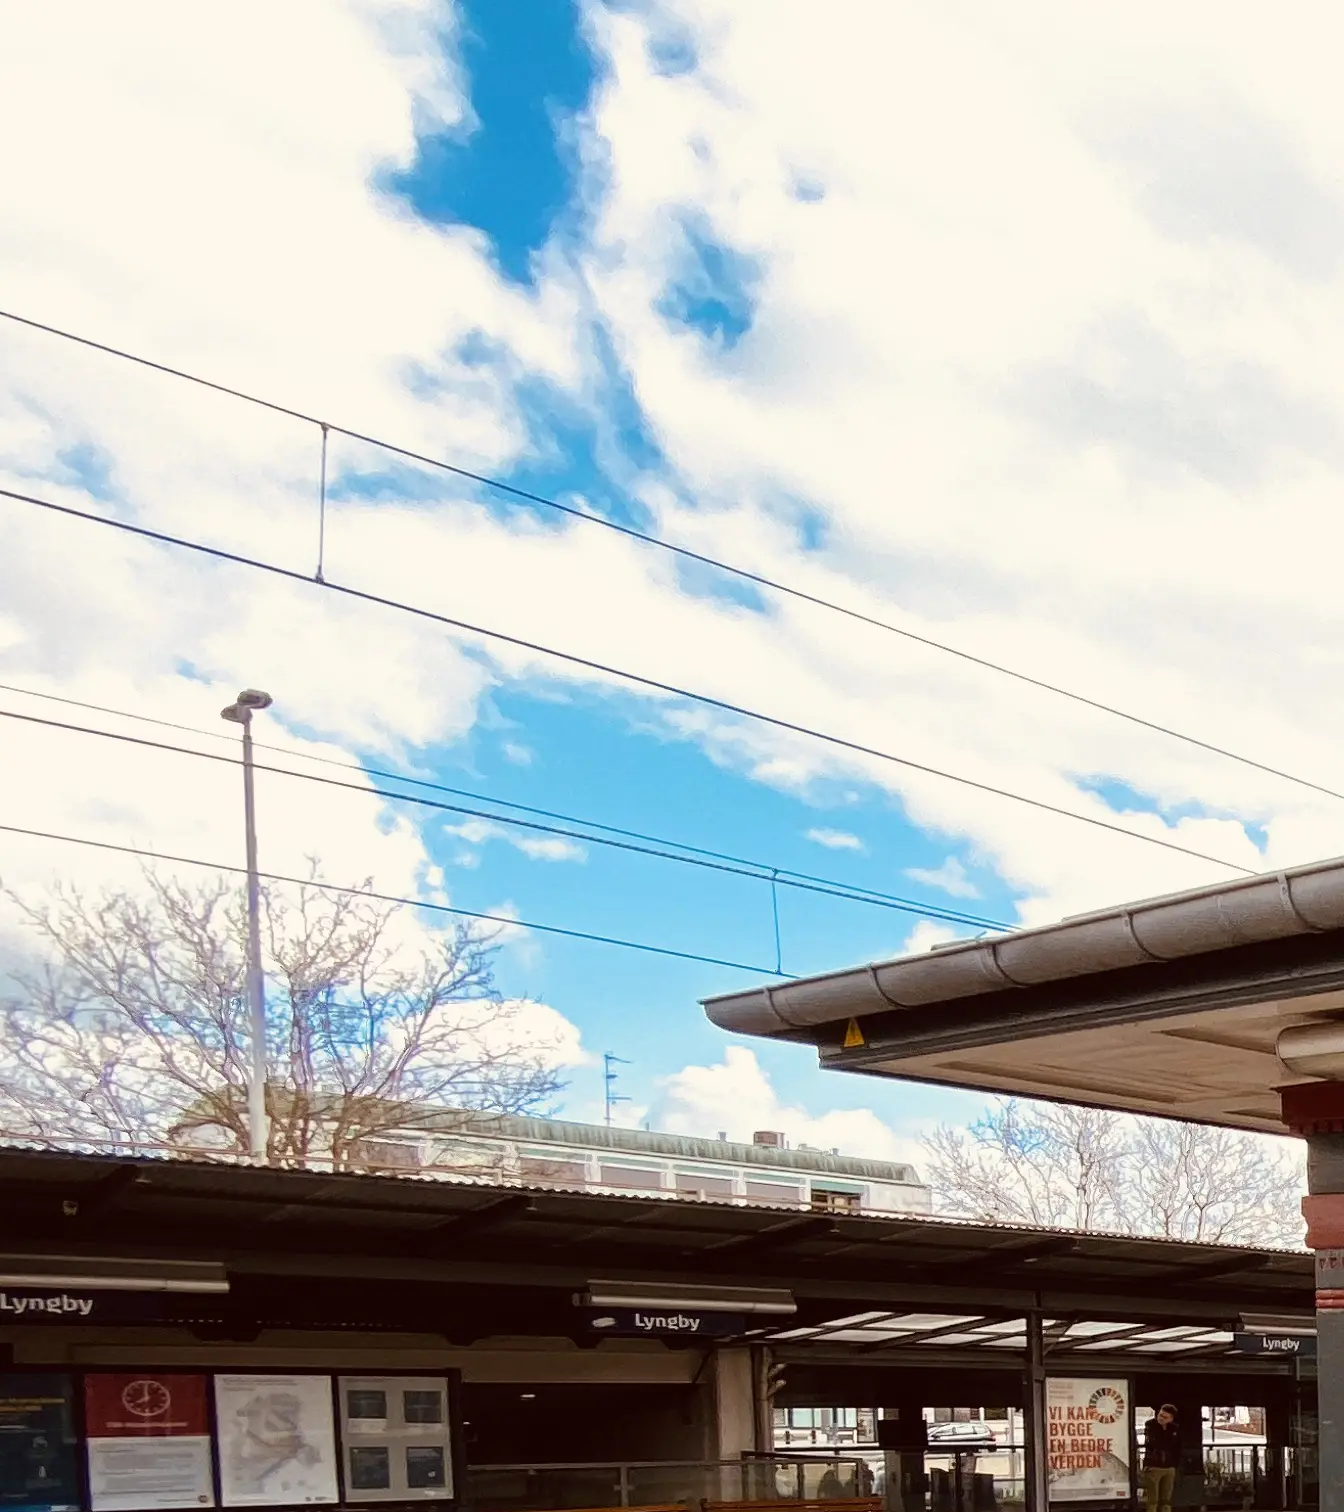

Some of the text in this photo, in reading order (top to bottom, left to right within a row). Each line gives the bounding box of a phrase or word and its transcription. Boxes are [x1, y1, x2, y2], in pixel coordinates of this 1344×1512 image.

[0, 1292, 94, 1316] Lyngby
[634, 1312, 701, 1332] Lyngby
[1262, 1336, 1300, 1352] Lyngby
[1048, 1406, 1097, 1421] VI KAN
[1049, 1422, 1093, 1437] BYGGE
[1049, 1438, 1114, 1453] EN BEDRE
[1049, 1454, 1102, 1470] VERDEN
